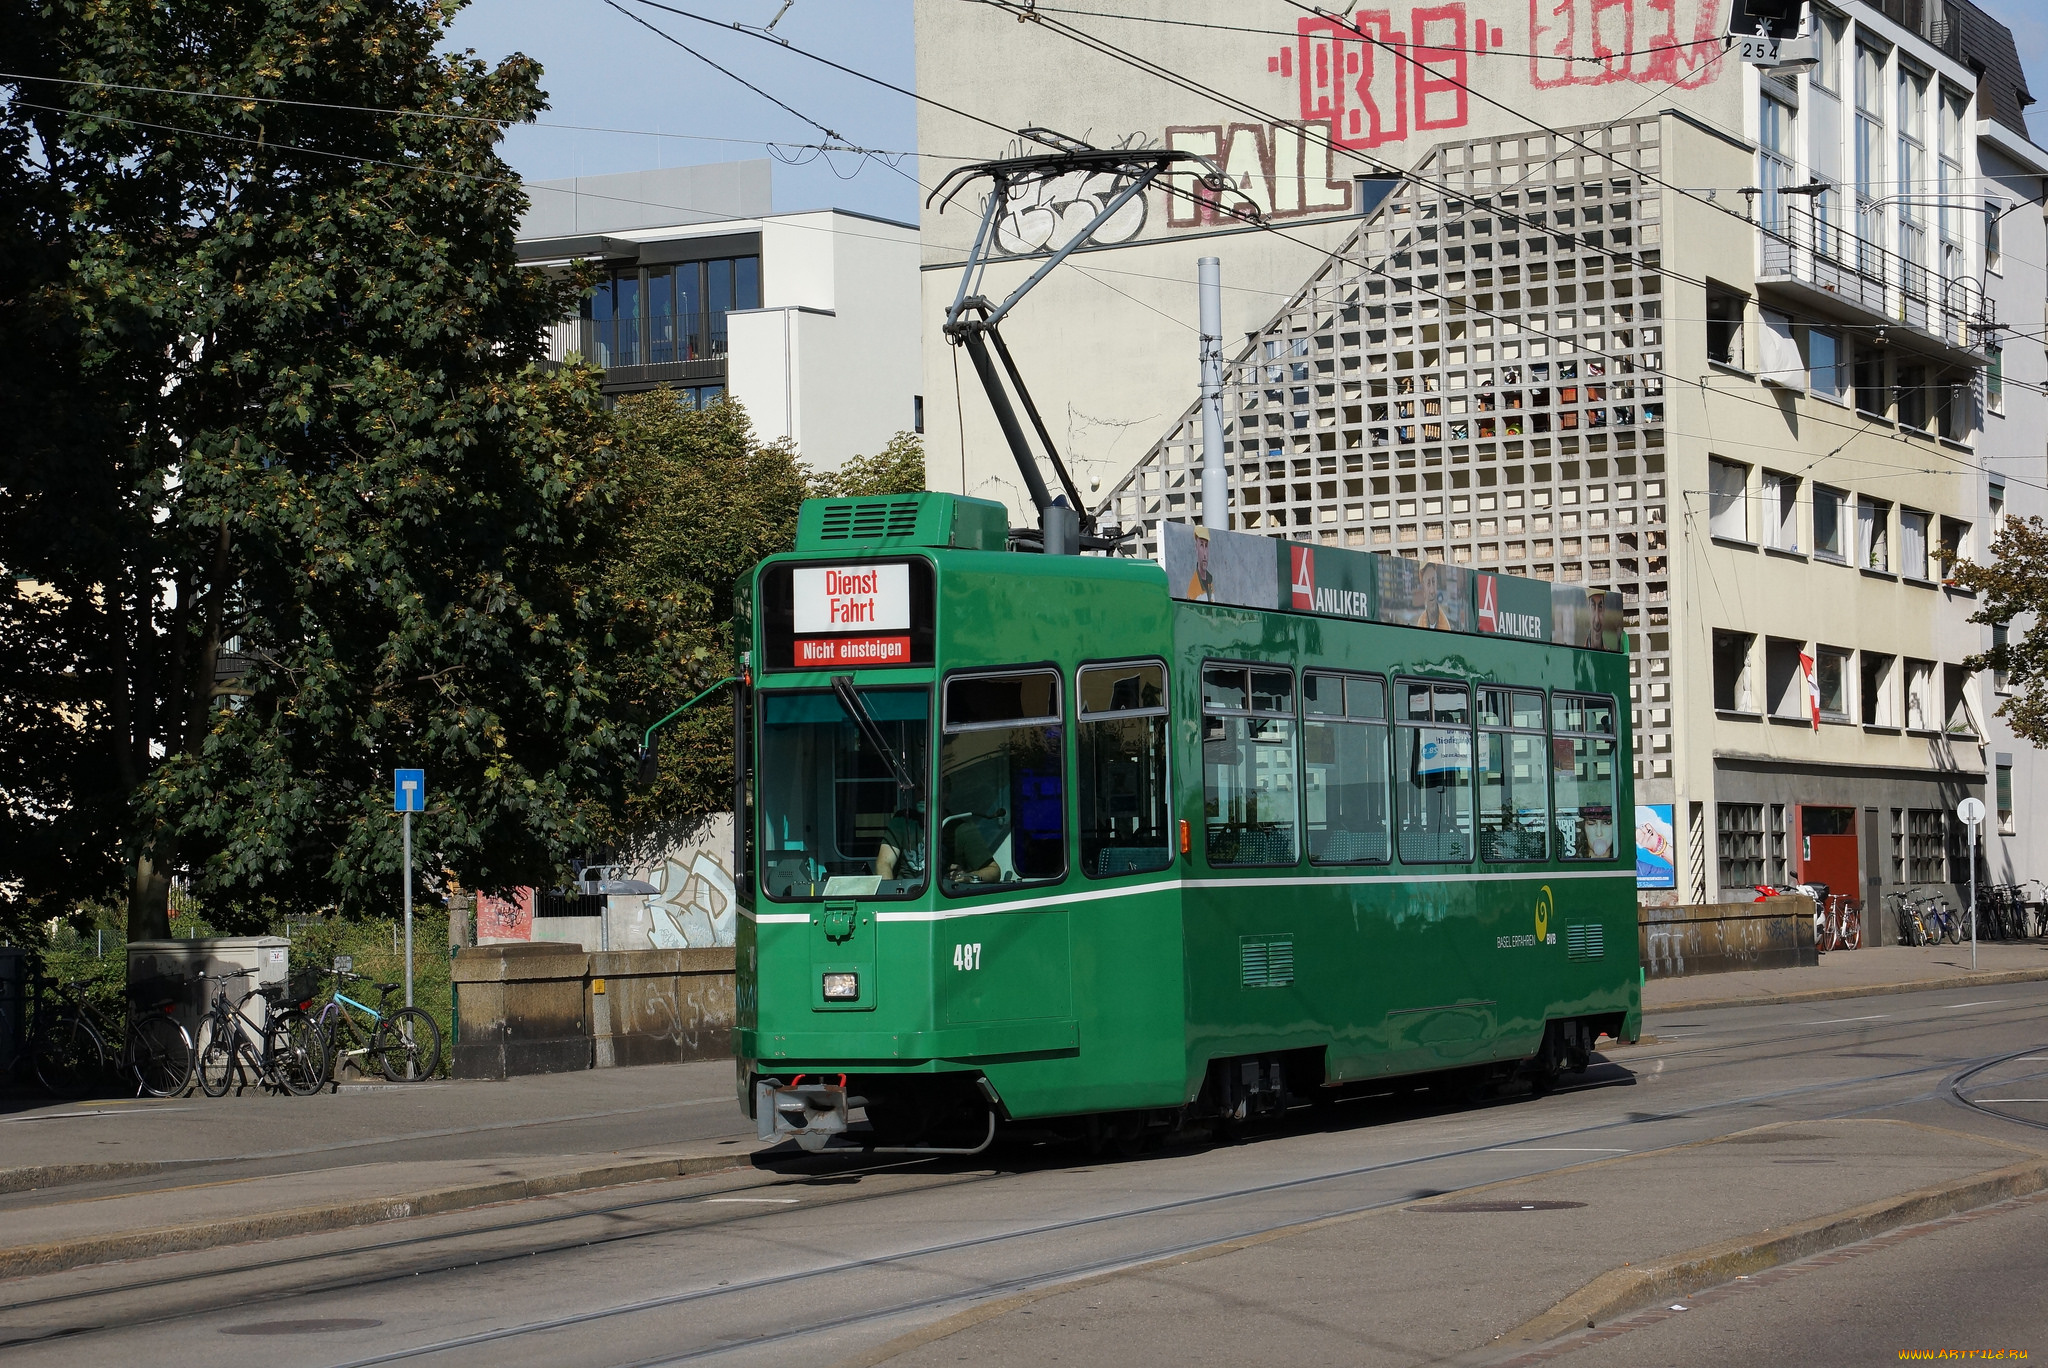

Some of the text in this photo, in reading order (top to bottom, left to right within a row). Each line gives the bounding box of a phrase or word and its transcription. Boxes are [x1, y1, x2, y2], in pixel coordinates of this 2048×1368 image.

[1743, 42, 1778, 60] 254
[1166, 120, 1352, 228] FAIL
[826, 570, 878, 595] Dienst
[830, 598, 875, 623] Fahrt
[1316, 587, 1368, 617] ANLIKER
[1498, 611, 1541, 638] ANLIKER
[803, 640, 902, 659] Nicht einsteigen
[1497, 933, 1556, 948] BASEL ERFAHREN BVB
[953, 943, 982, 971] 487
